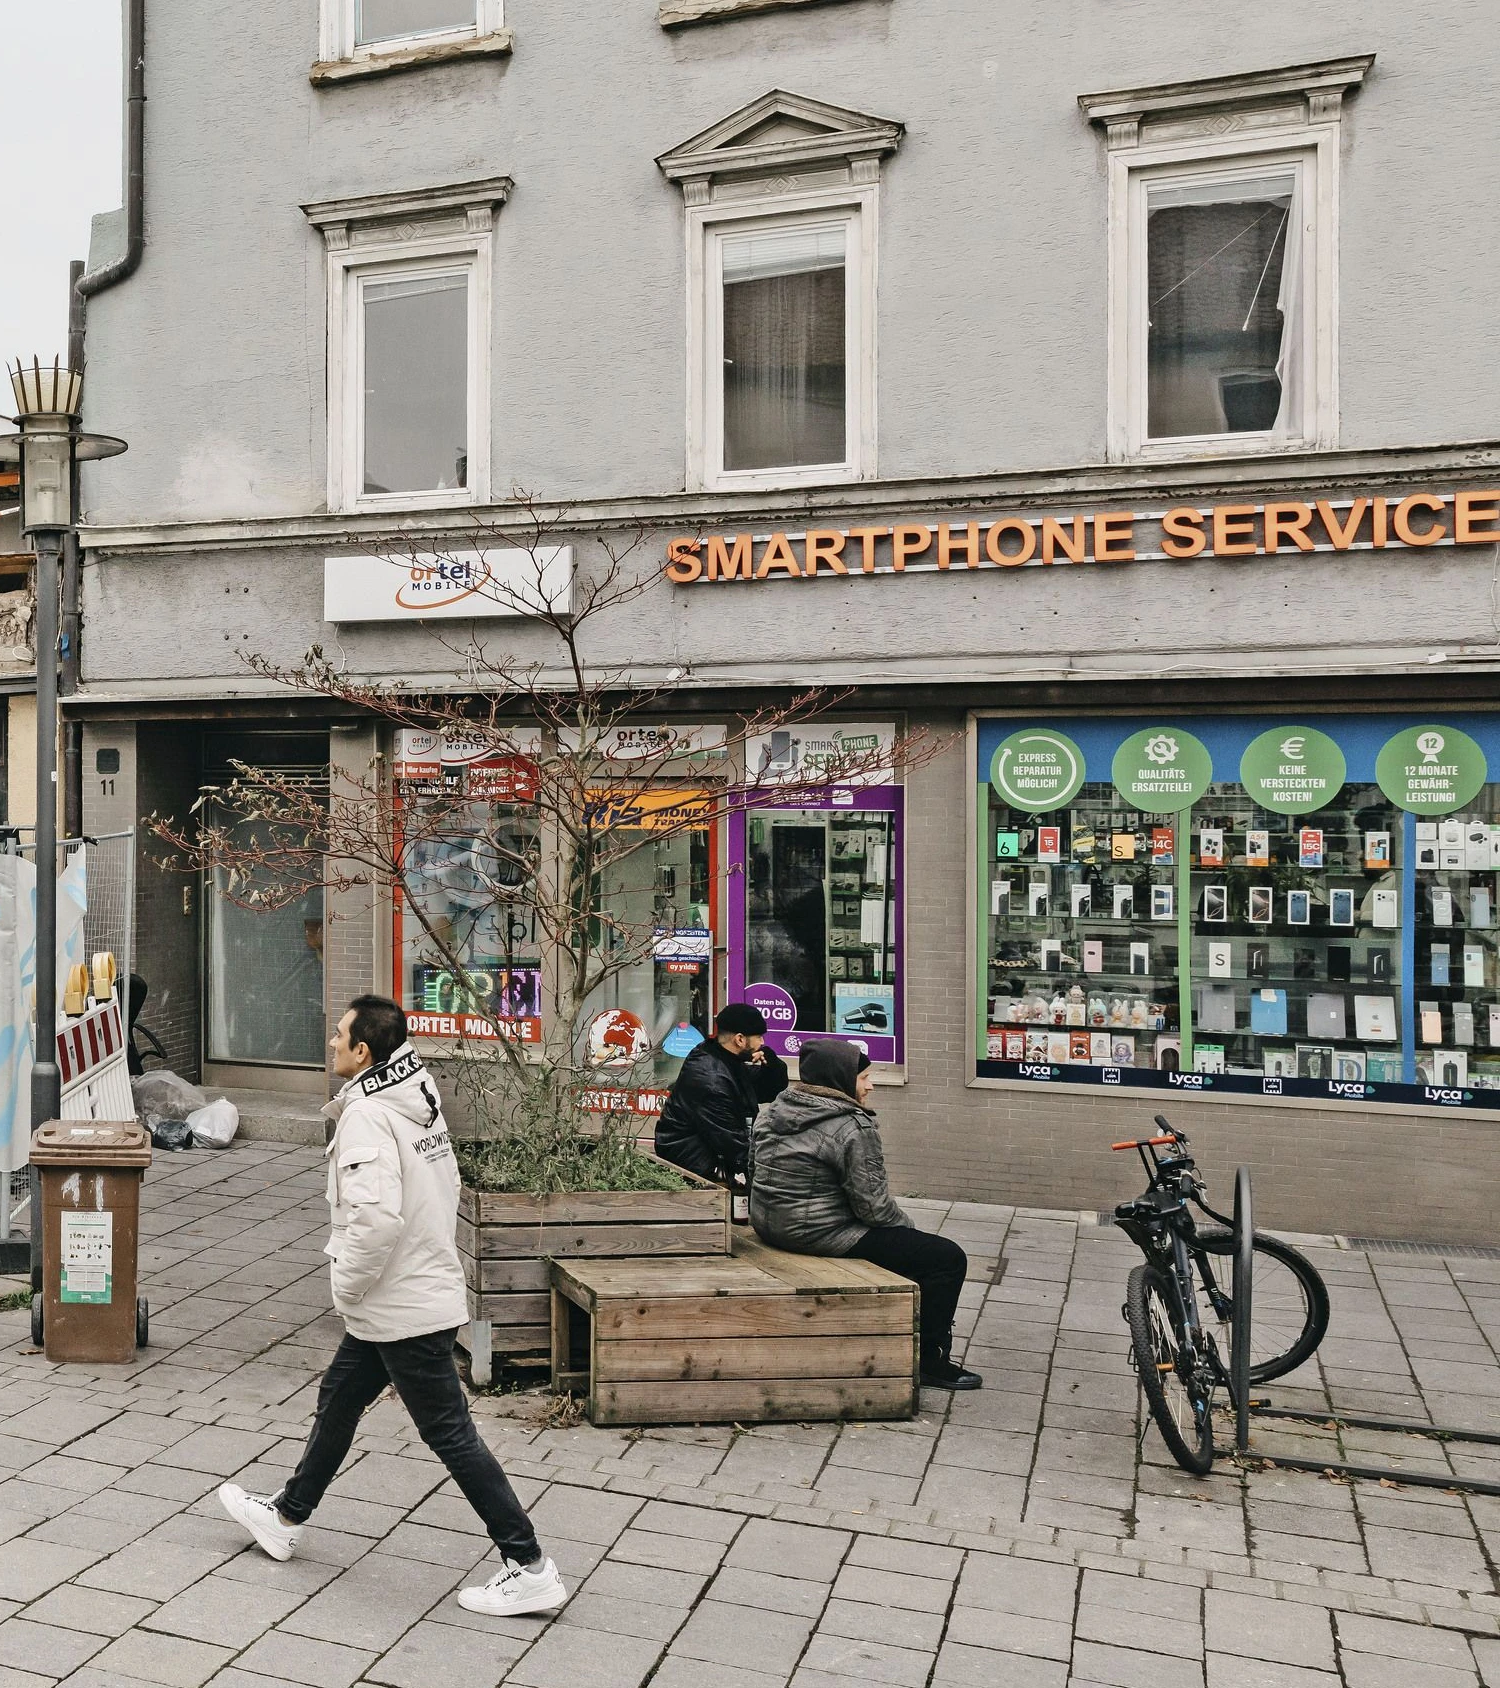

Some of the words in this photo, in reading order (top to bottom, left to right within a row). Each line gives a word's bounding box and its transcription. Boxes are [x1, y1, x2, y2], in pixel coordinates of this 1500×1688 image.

[666, 512, 1136, 584] SMARTPHONE
[1160, 489, 1500, 559] SERVICE
[409, 560, 471, 583] ortel
[411, 581, 472, 592] MOBILE
[412, 736, 432, 745] ortel
[616, 728, 660, 741] orte
[1423, 737, 1438, 749] 12
[1018, 753, 1057, 763] EXPRESS
[1013, 766, 1062, 776] REPARATUR
[1138, 767, 1186, 780] QUALITÄTS
[1279, 765, 1307, 775] KEINE
[1404, 765, 1416, 776] 12
[1418, 765, 1458, 776] MONATE
[100, 779, 116, 796] 11
[1017, 777, 1058, 789] MÖGLICH!
[1131, 782, 1192, 793] ERSATZTEILE!
[1260, 778, 1326, 789] VERSTECKTEN
[1408, 777, 1454, 789] GEWÄHR-
[1273, 791, 1313, 802] KOSTEN!
[1406, 791, 1456, 803] LEISTUNG!
[1043, 839, 1054, 847] 15
[1153, 840, 1173, 850] 14C
[772, 1008, 793, 1021] GB
[407, 1015, 461, 1035] ORTEL
[364, 1056, 415, 1093] BLACK
[1018, 1062, 1051, 1076] Lyca
[1168, 1072, 1203, 1085] Lyca
[1328, 1080, 1365, 1094] Lyca
[1424, 1086, 1463, 1100] Lyca
